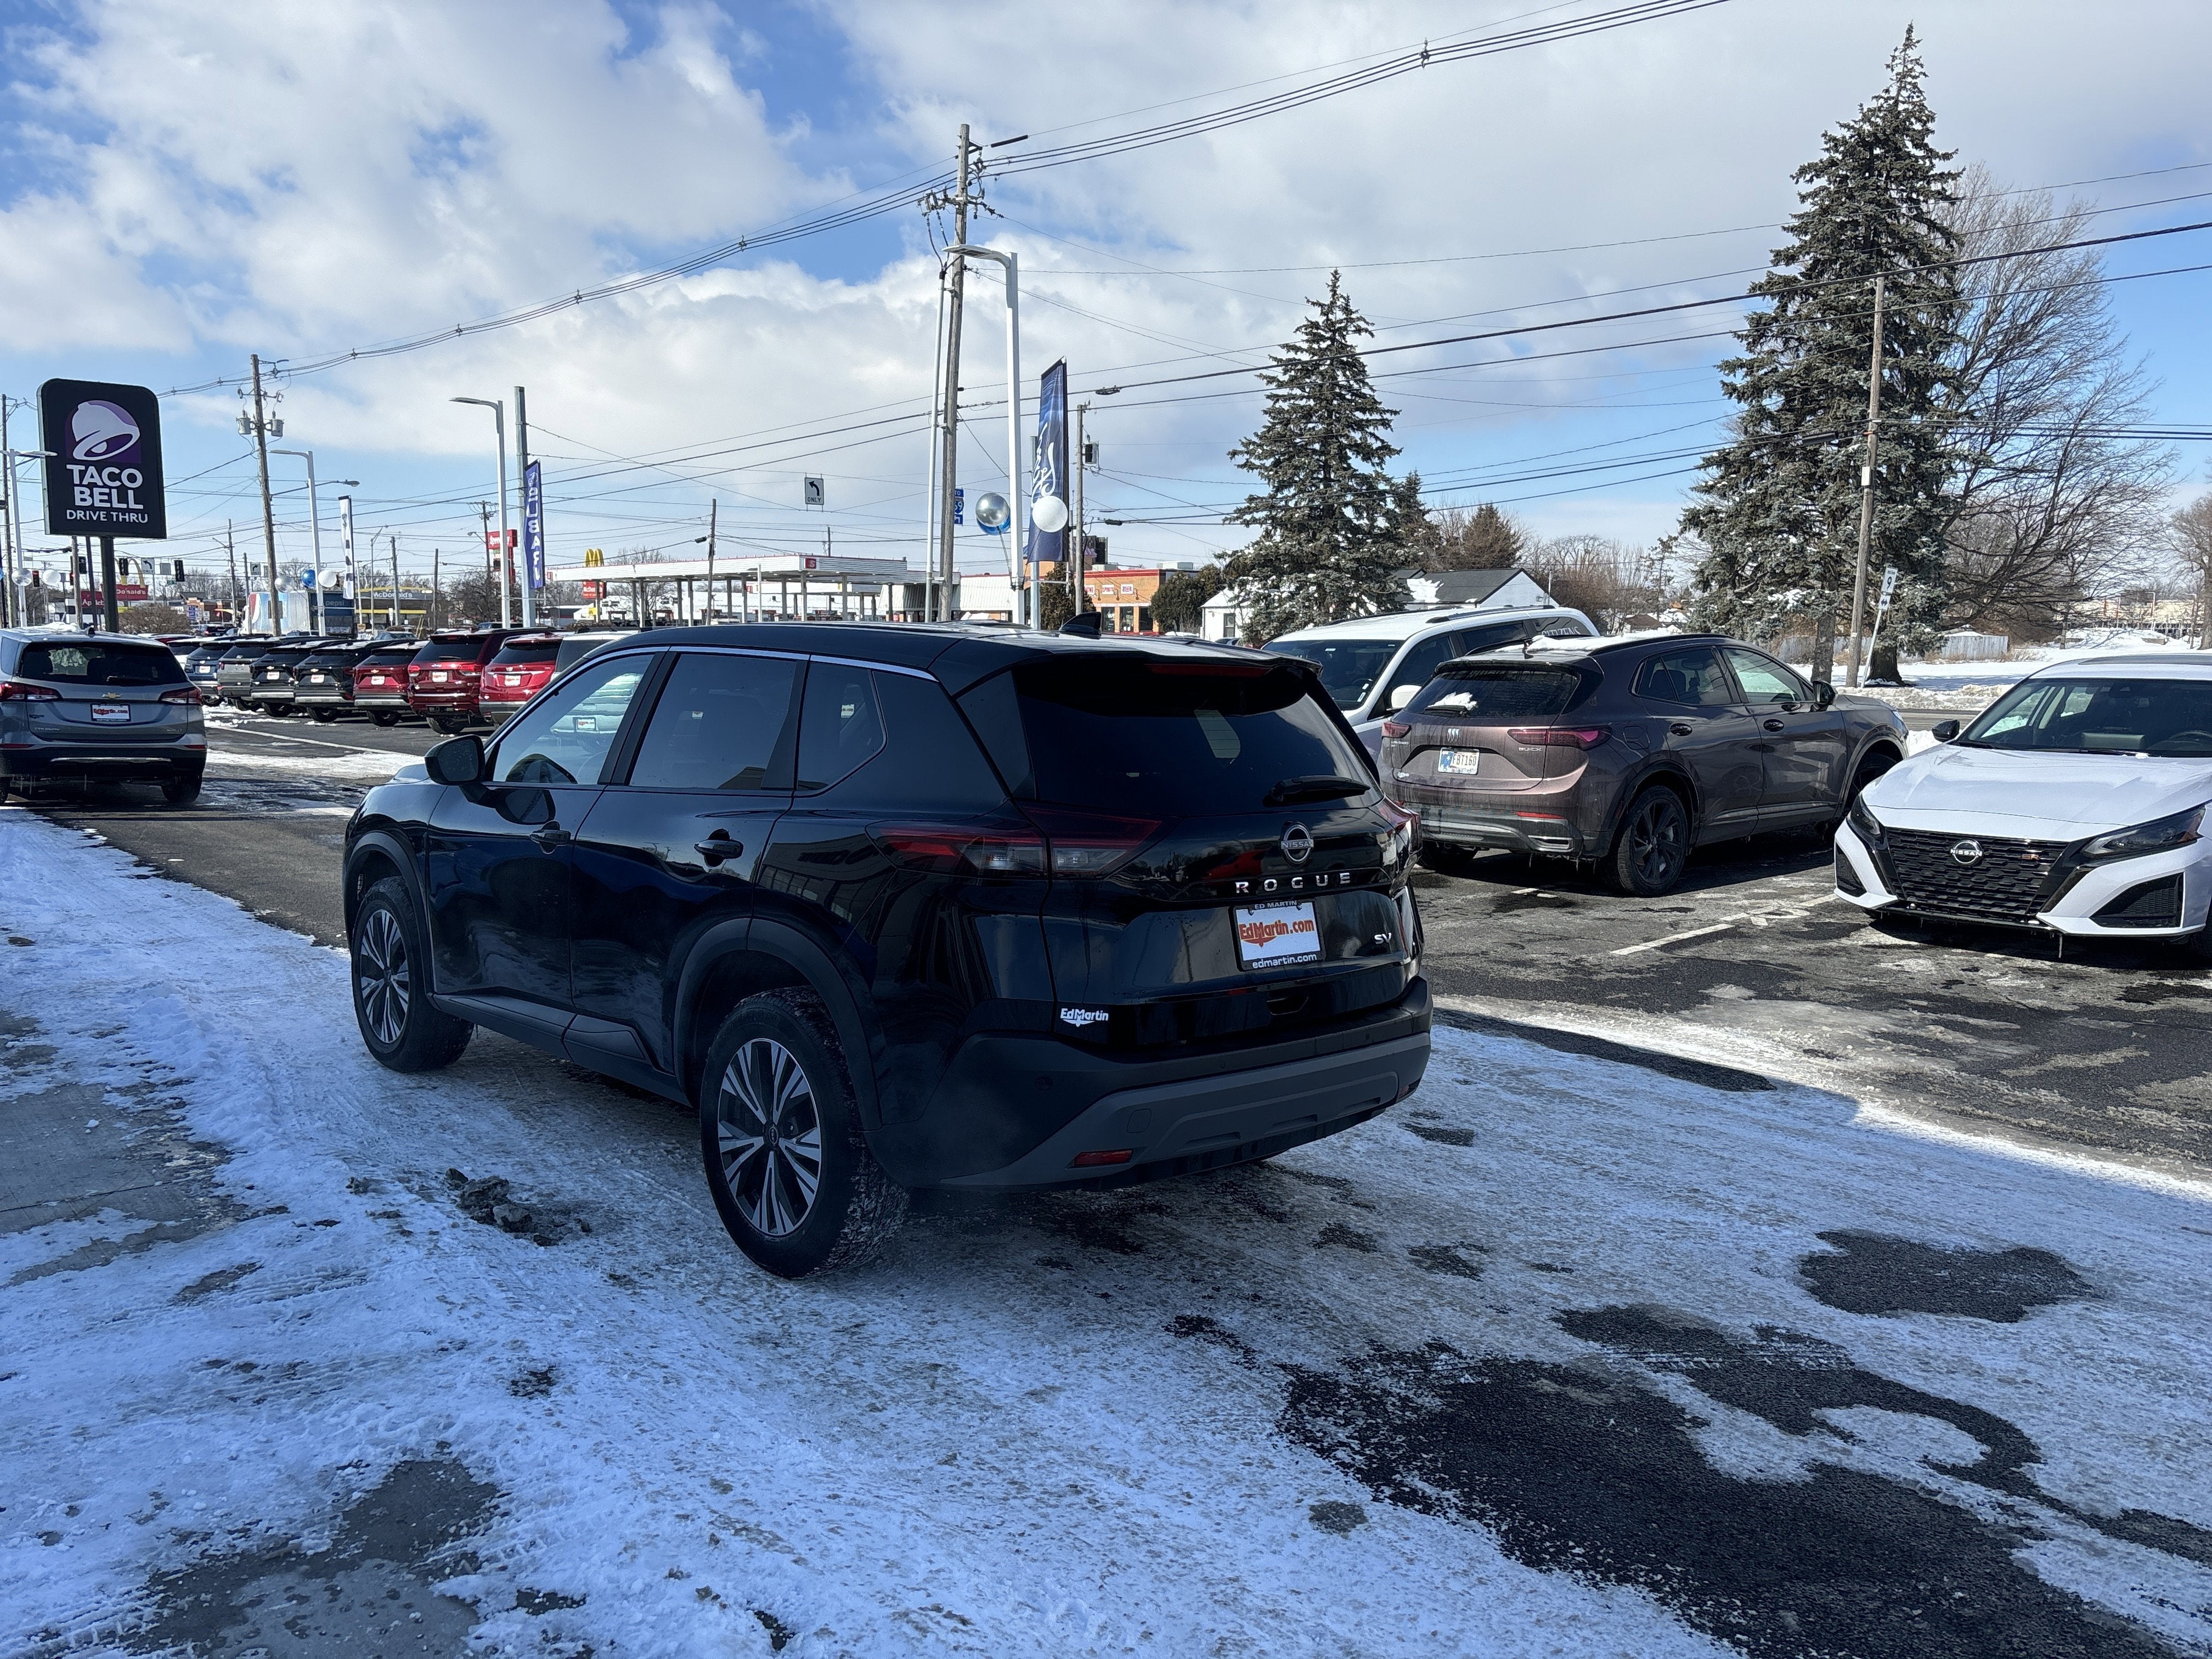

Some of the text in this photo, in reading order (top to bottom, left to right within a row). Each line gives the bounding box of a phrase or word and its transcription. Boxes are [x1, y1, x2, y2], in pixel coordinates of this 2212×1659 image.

[66, 464, 143, 488] TACO
[74, 486, 144, 510] BELL
[66, 509, 148, 523] DRIVE THRU
[1887, 576, 1892, 590] 9
[1541, 626, 1581, 636] CITIZENS
[1452, 754, 1477, 766] FBT160
[1282, 840, 1313, 849] NISSAN
[1234, 872, 1351, 894] ROGUE
[1267, 900, 1297, 909] MARTIN
[1239, 919, 1314, 940] EdMartin.com
[1374, 933, 1392, 944] SV
[1252, 954, 1317, 969] edmartin.com
[1060, 1008, 1109, 1021] EdMartin
